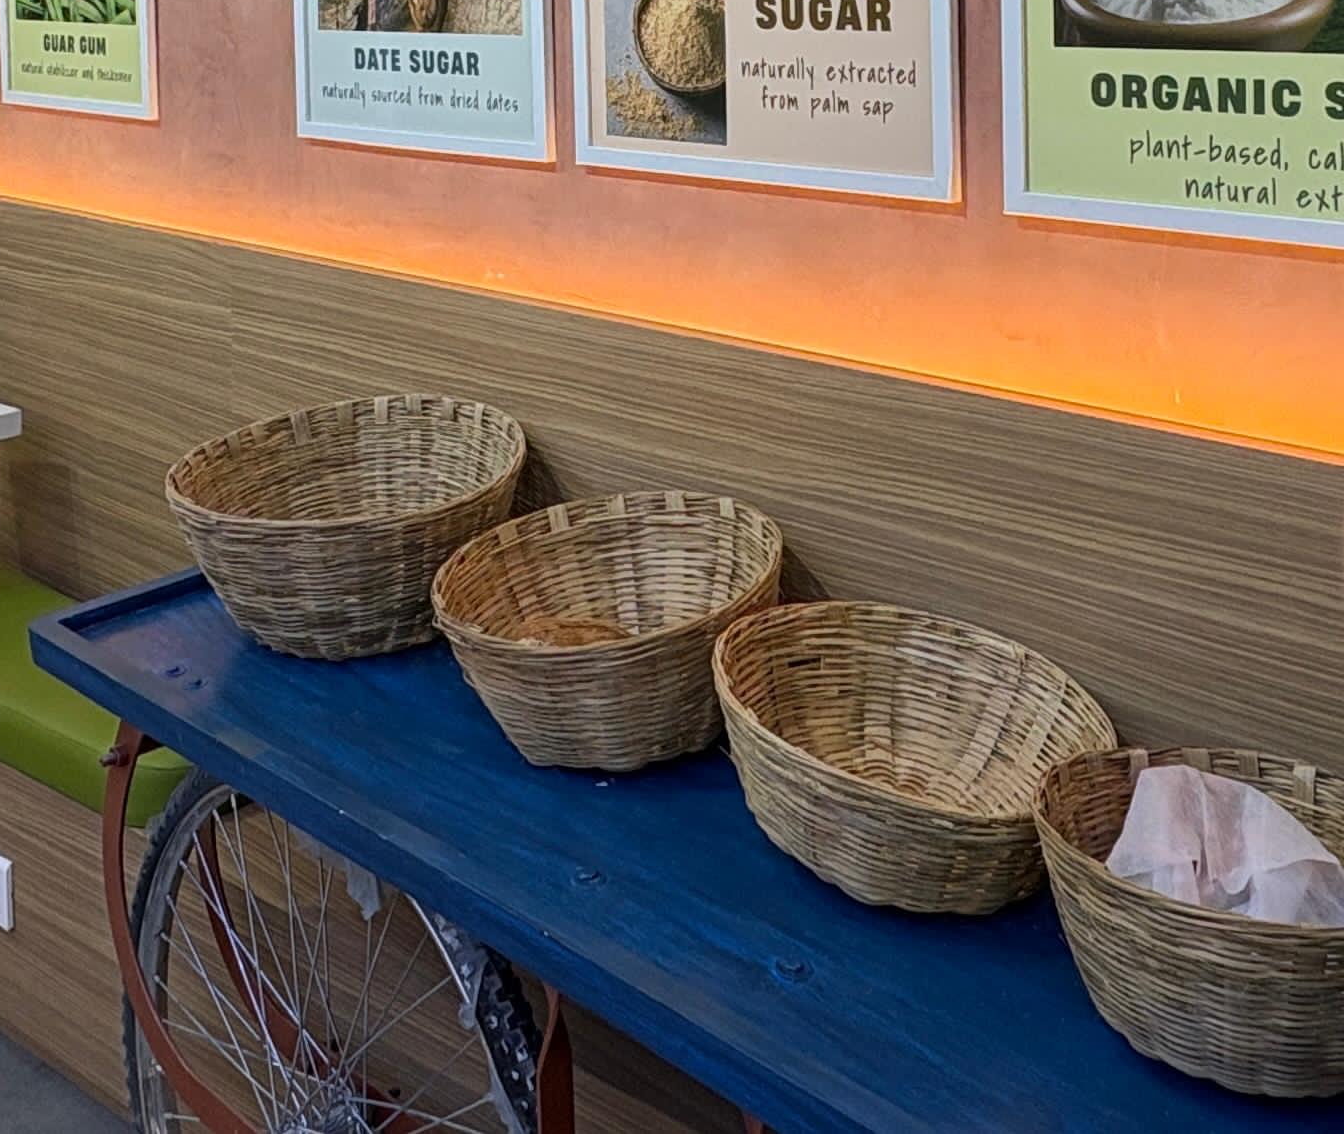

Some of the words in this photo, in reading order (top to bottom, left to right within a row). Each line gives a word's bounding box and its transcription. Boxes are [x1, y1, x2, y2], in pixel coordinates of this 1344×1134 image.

[43, 33, 75, 53] GUAR
[79, 36, 106, 56] GUM
[354, 47, 401, 72] DATE
[409, 49, 480, 76] SUGAR
[741, 57, 815, 89] naturally
[826, 60, 917, 88] extracted
[322, 82, 365, 109] naturally
[371, 85, 411, 105] sourced
[418, 86, 444, 107] from
[450, 87, 479, 110] dried
[486, 89, 519, 114] dates
[762, 85, 799, 111] from
[811, 90, 849, 118] palm
[863, 99, 894, 123] sap
[1090, 72, 1303, 118] ORGANIC
[1129, 133, 1290, 171] plant-based,
[1184, 175, 1277, 207] natural
